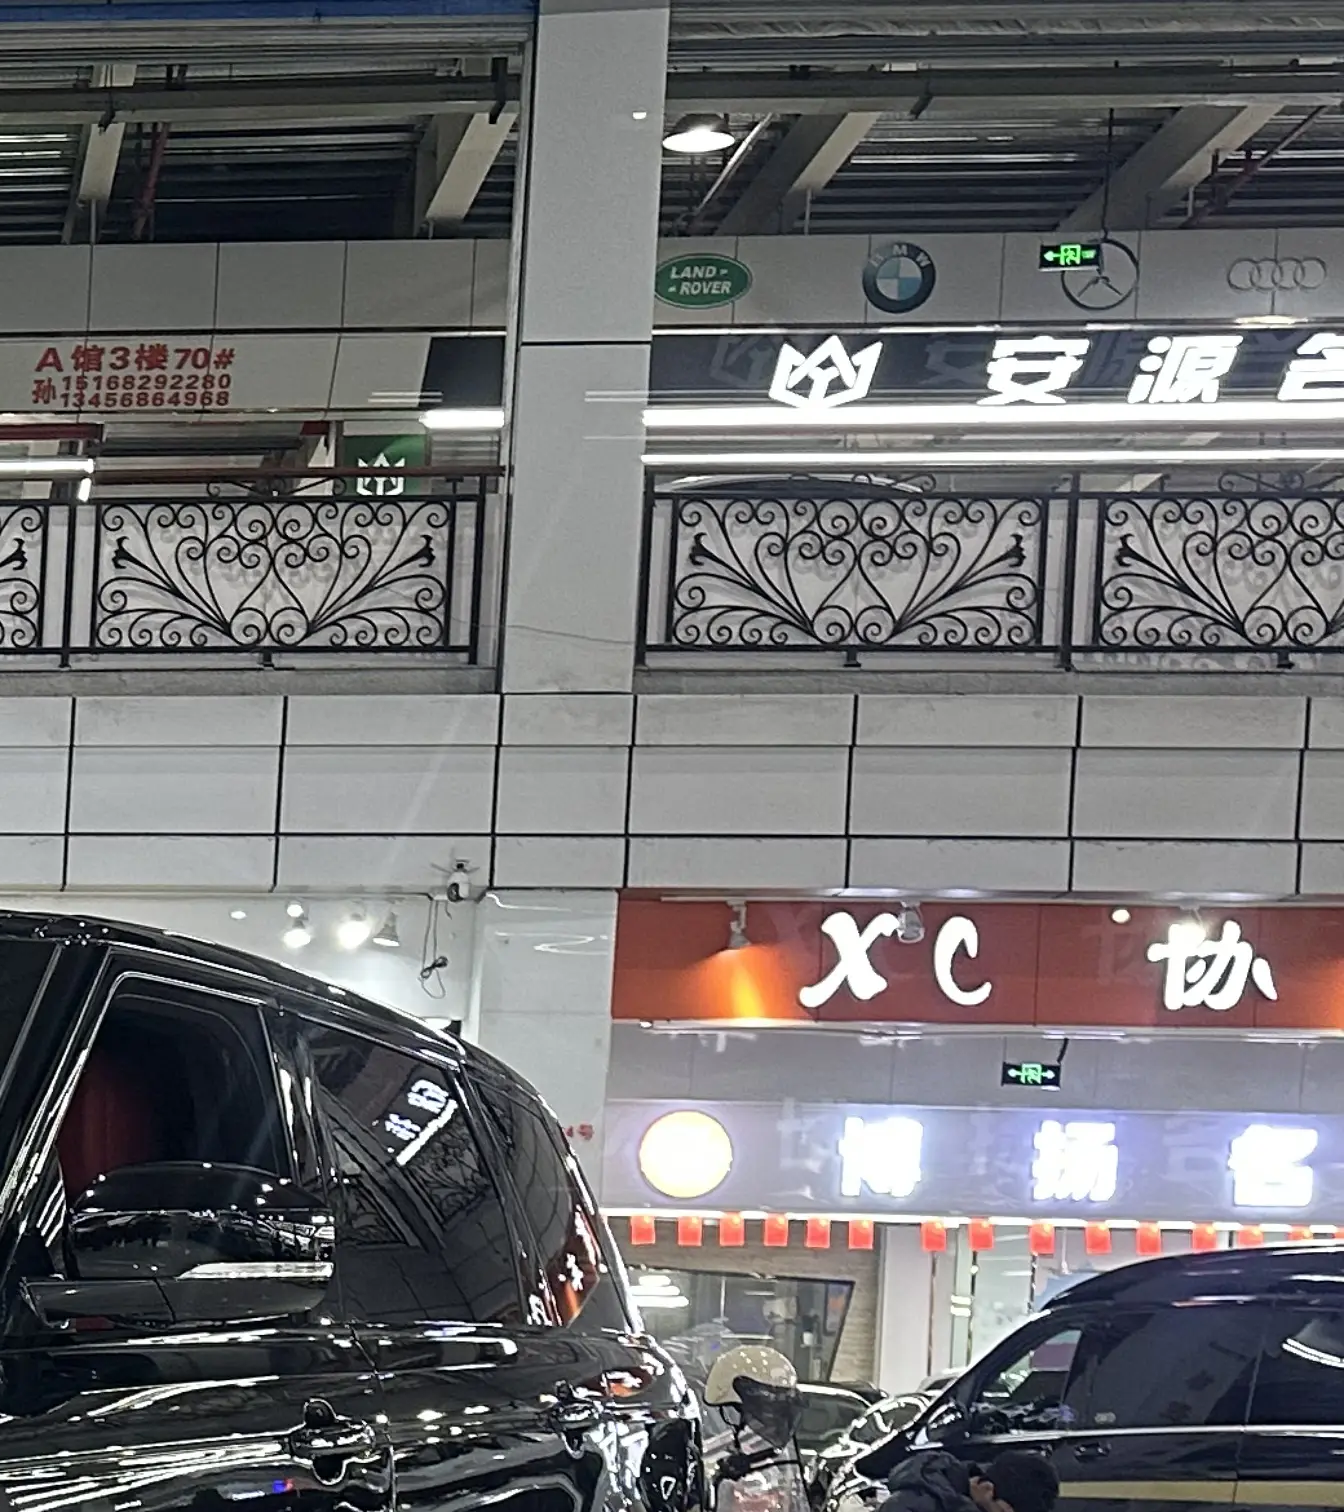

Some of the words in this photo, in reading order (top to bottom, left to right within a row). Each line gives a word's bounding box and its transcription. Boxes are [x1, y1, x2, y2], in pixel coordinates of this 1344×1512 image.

[670, 265, 717, 279] LAND
[679, 280, 733, 295] ROVER
[32, 377, 57, 405] 孙
[62, 374, 232, 391] 15168292280
[60, 391, 231, 408] 13456864968
[1147, 919, 1279, 1012] 协
